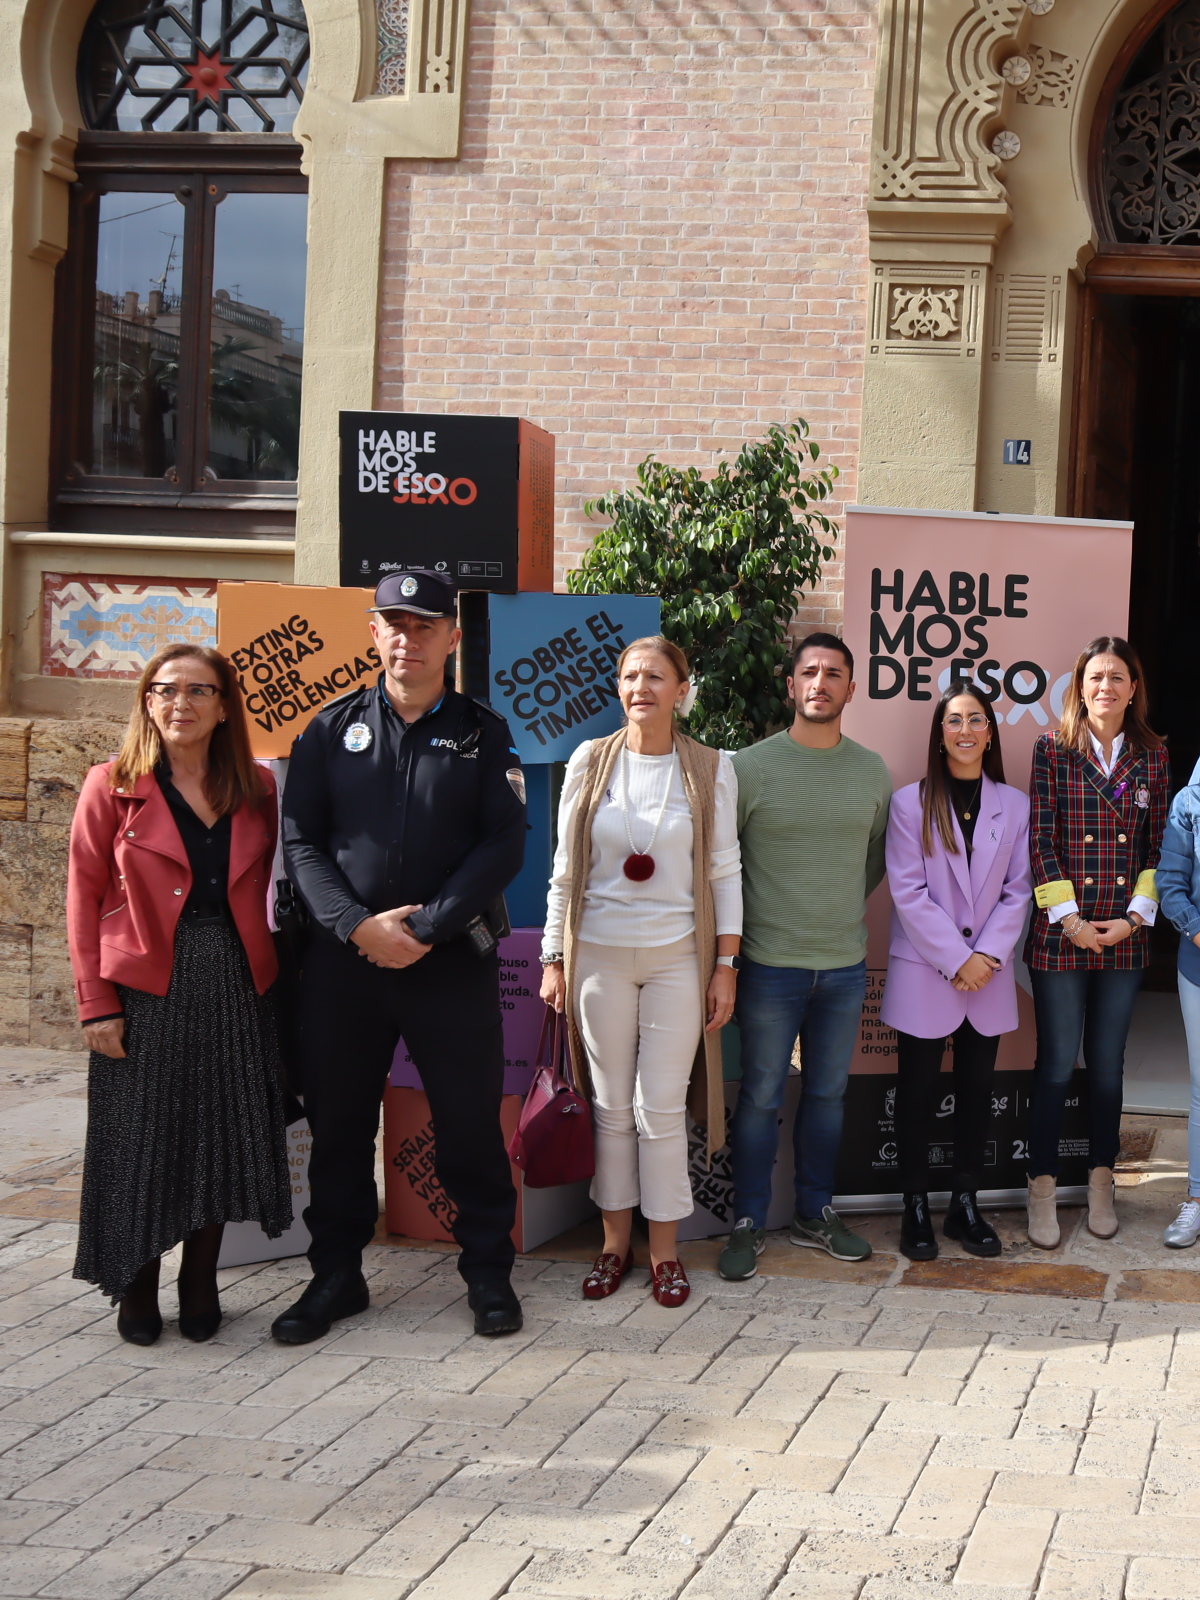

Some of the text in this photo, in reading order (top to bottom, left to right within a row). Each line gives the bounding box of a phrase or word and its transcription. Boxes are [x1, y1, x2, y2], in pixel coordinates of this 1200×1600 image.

[358, 429, 436, 453] HABLE
[1006, 441, 1029, 463] 14
[358, 449, 417, 473] MOS
[358, 471, 447, 495] DE ESO
[870, 567, 1030, 618] HABLE
[869, 611, 989, 659] MOS
[252, 630, 325, 684] OTRAS
[495, 610, 624, 697] SOBRE EL
[255, 646, 383, 733] VIOLENCIAS
[512, 636, 627, 719] CONSEN
[868, 655, 933, 701] DE
[246, 669, 306, 715] CIBER
[525, 671, 620, 746] TIMIEN
[499, 957, 529, 968] buso
[500, 971, 519, 982] ble
[500, 985, 534, 998] yuda,
[864, 989, 883, 1000] sól
[861, 1030, 898, 1041] la infl
[861, 1043, 899, 1057] droga
[406, 1143, 436, 1188] ALER
[415, 1173, 442, 1201] VIO
